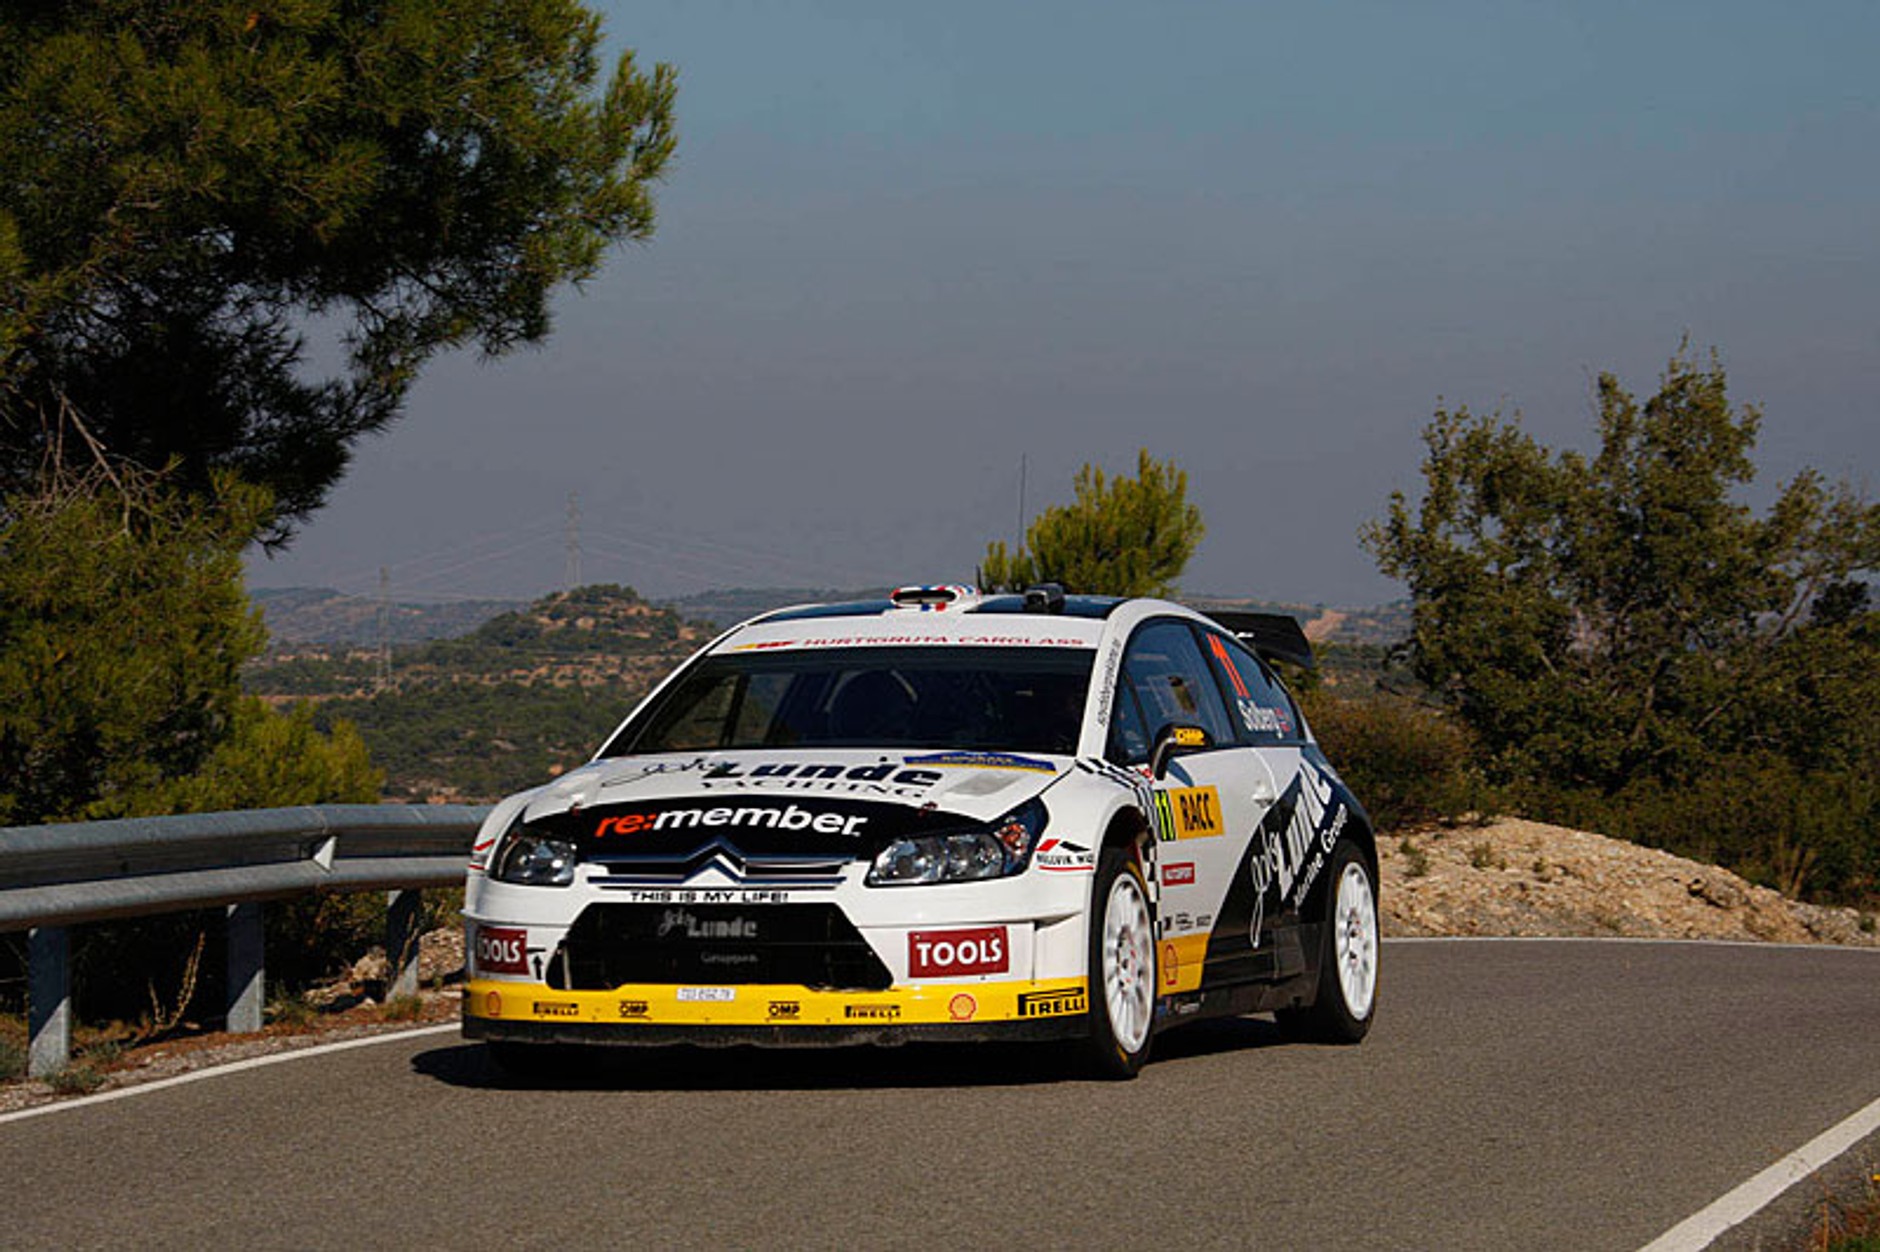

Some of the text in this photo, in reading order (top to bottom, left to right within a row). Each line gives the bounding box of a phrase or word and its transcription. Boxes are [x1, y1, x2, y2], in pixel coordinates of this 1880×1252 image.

[1237, 698, 1283, 739] Solberg
[703, 763, 943, 786] Lunde
[701, 780, 926, 799] YACHTING
[594, 804, 869, 838] re:member
[1179, 792, 1216, 832] RACC
[631, 892, 789, 903] THIS IS MY LIFE!
[687, 917, 758, 938] Lunde
[916, 938, 1003, 967] TOOLS
[618, 1001, 650, 1017] OMP
[768, 1001, 800, 1018] OMP
[1018, 986, 1086, 1017] PIRELLI
